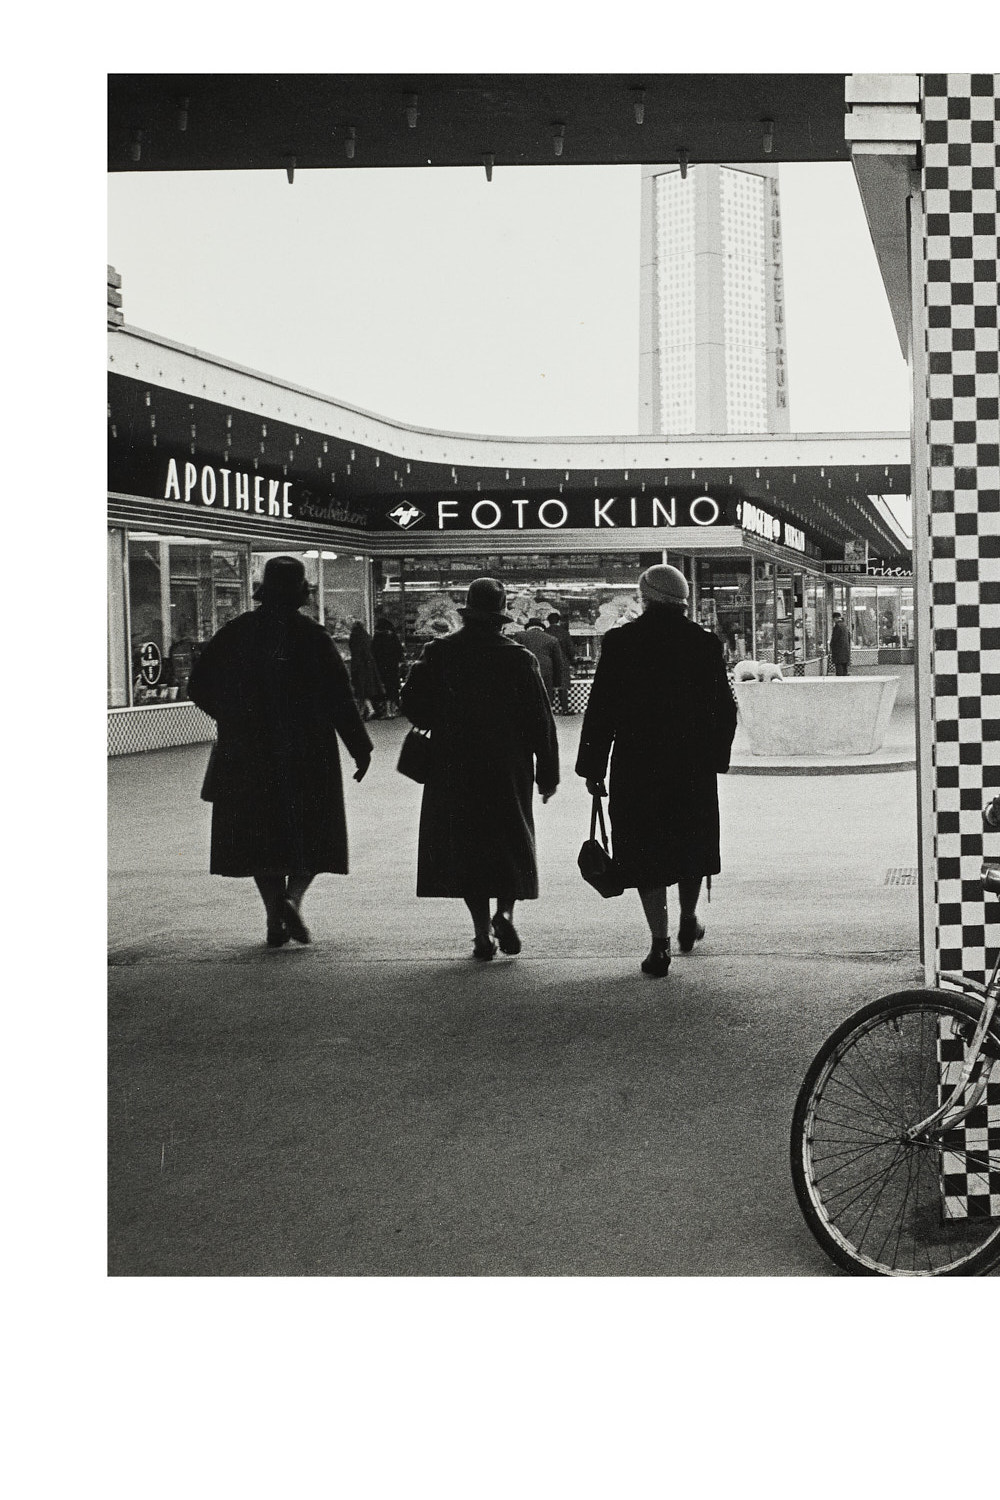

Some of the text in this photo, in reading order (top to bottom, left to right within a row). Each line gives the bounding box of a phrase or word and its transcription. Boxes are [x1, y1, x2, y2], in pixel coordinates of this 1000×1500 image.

[164, 458, 293, 518] APOTHEKE
[437, 496, 719, 529] FOTO KINO
[831, 564, 861, 572] UHREN
